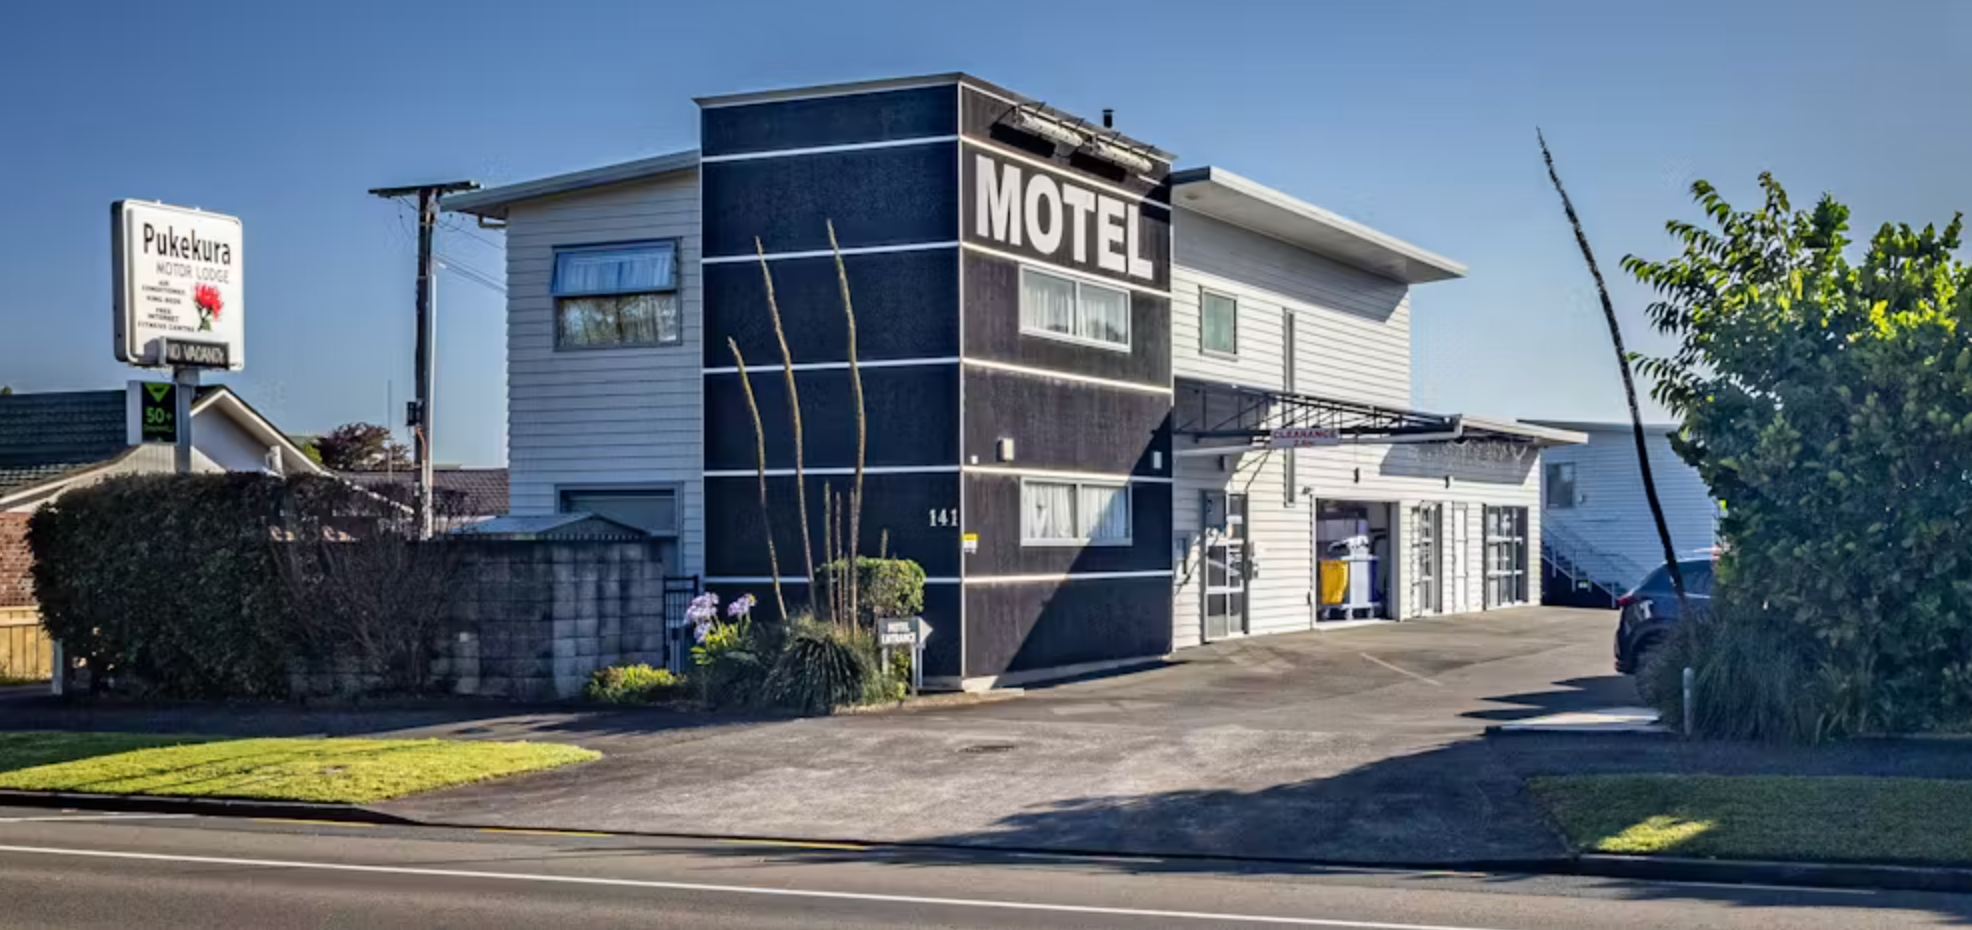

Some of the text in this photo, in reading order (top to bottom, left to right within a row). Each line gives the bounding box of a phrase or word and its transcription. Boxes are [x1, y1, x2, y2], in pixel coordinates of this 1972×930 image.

[976, 154, 1153, 280] MOTEL
[143, 222, 231, 265] Pukekura
[156, 261, 230, 284] MOTOR LODGE
[166, 343, 225, 365] NO VACANCY
[145, 407, 173, 423] 50+
[1273, 429, 1337, 439] CLEARANCE
[929, 508, 958, 527] 141
